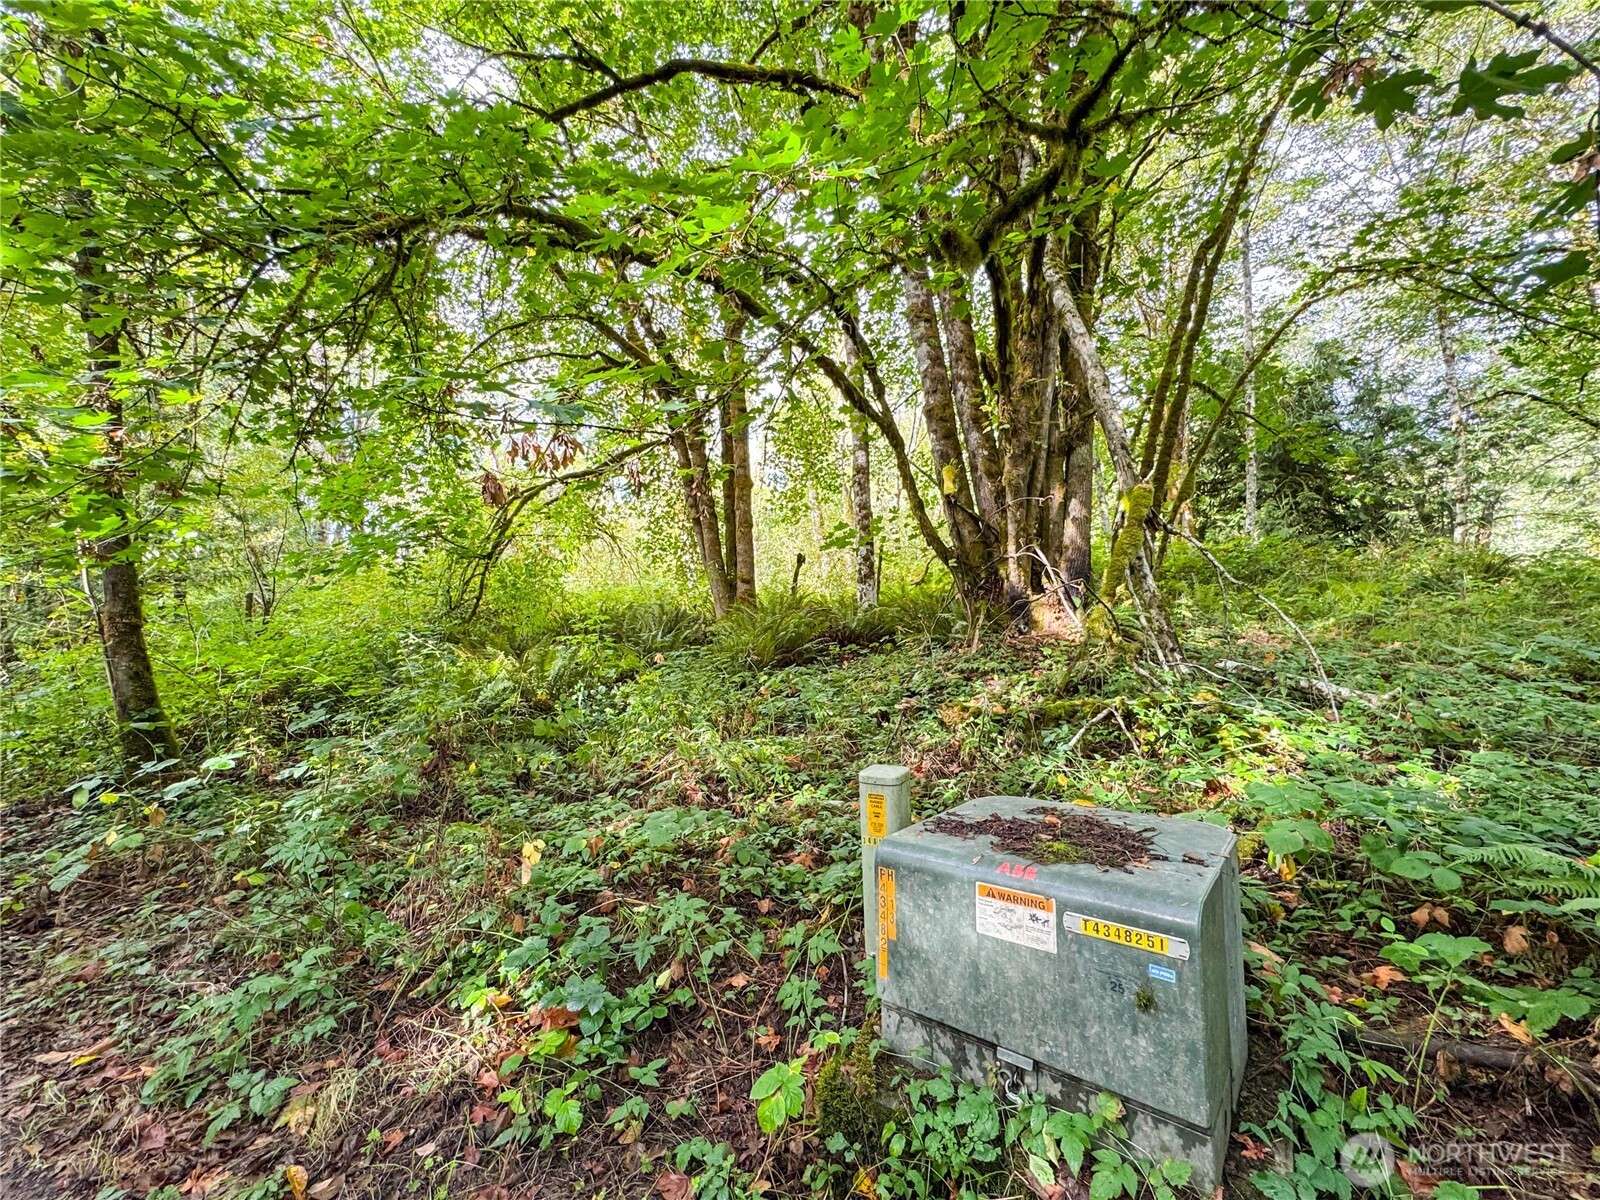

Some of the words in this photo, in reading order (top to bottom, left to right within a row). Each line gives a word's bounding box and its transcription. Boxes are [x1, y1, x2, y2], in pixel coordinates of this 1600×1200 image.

[997, 891, 1046, 910] WARNING
[1082, 918, 1164, 951] T4348251
[1110, 981, 1124, 994] 25
